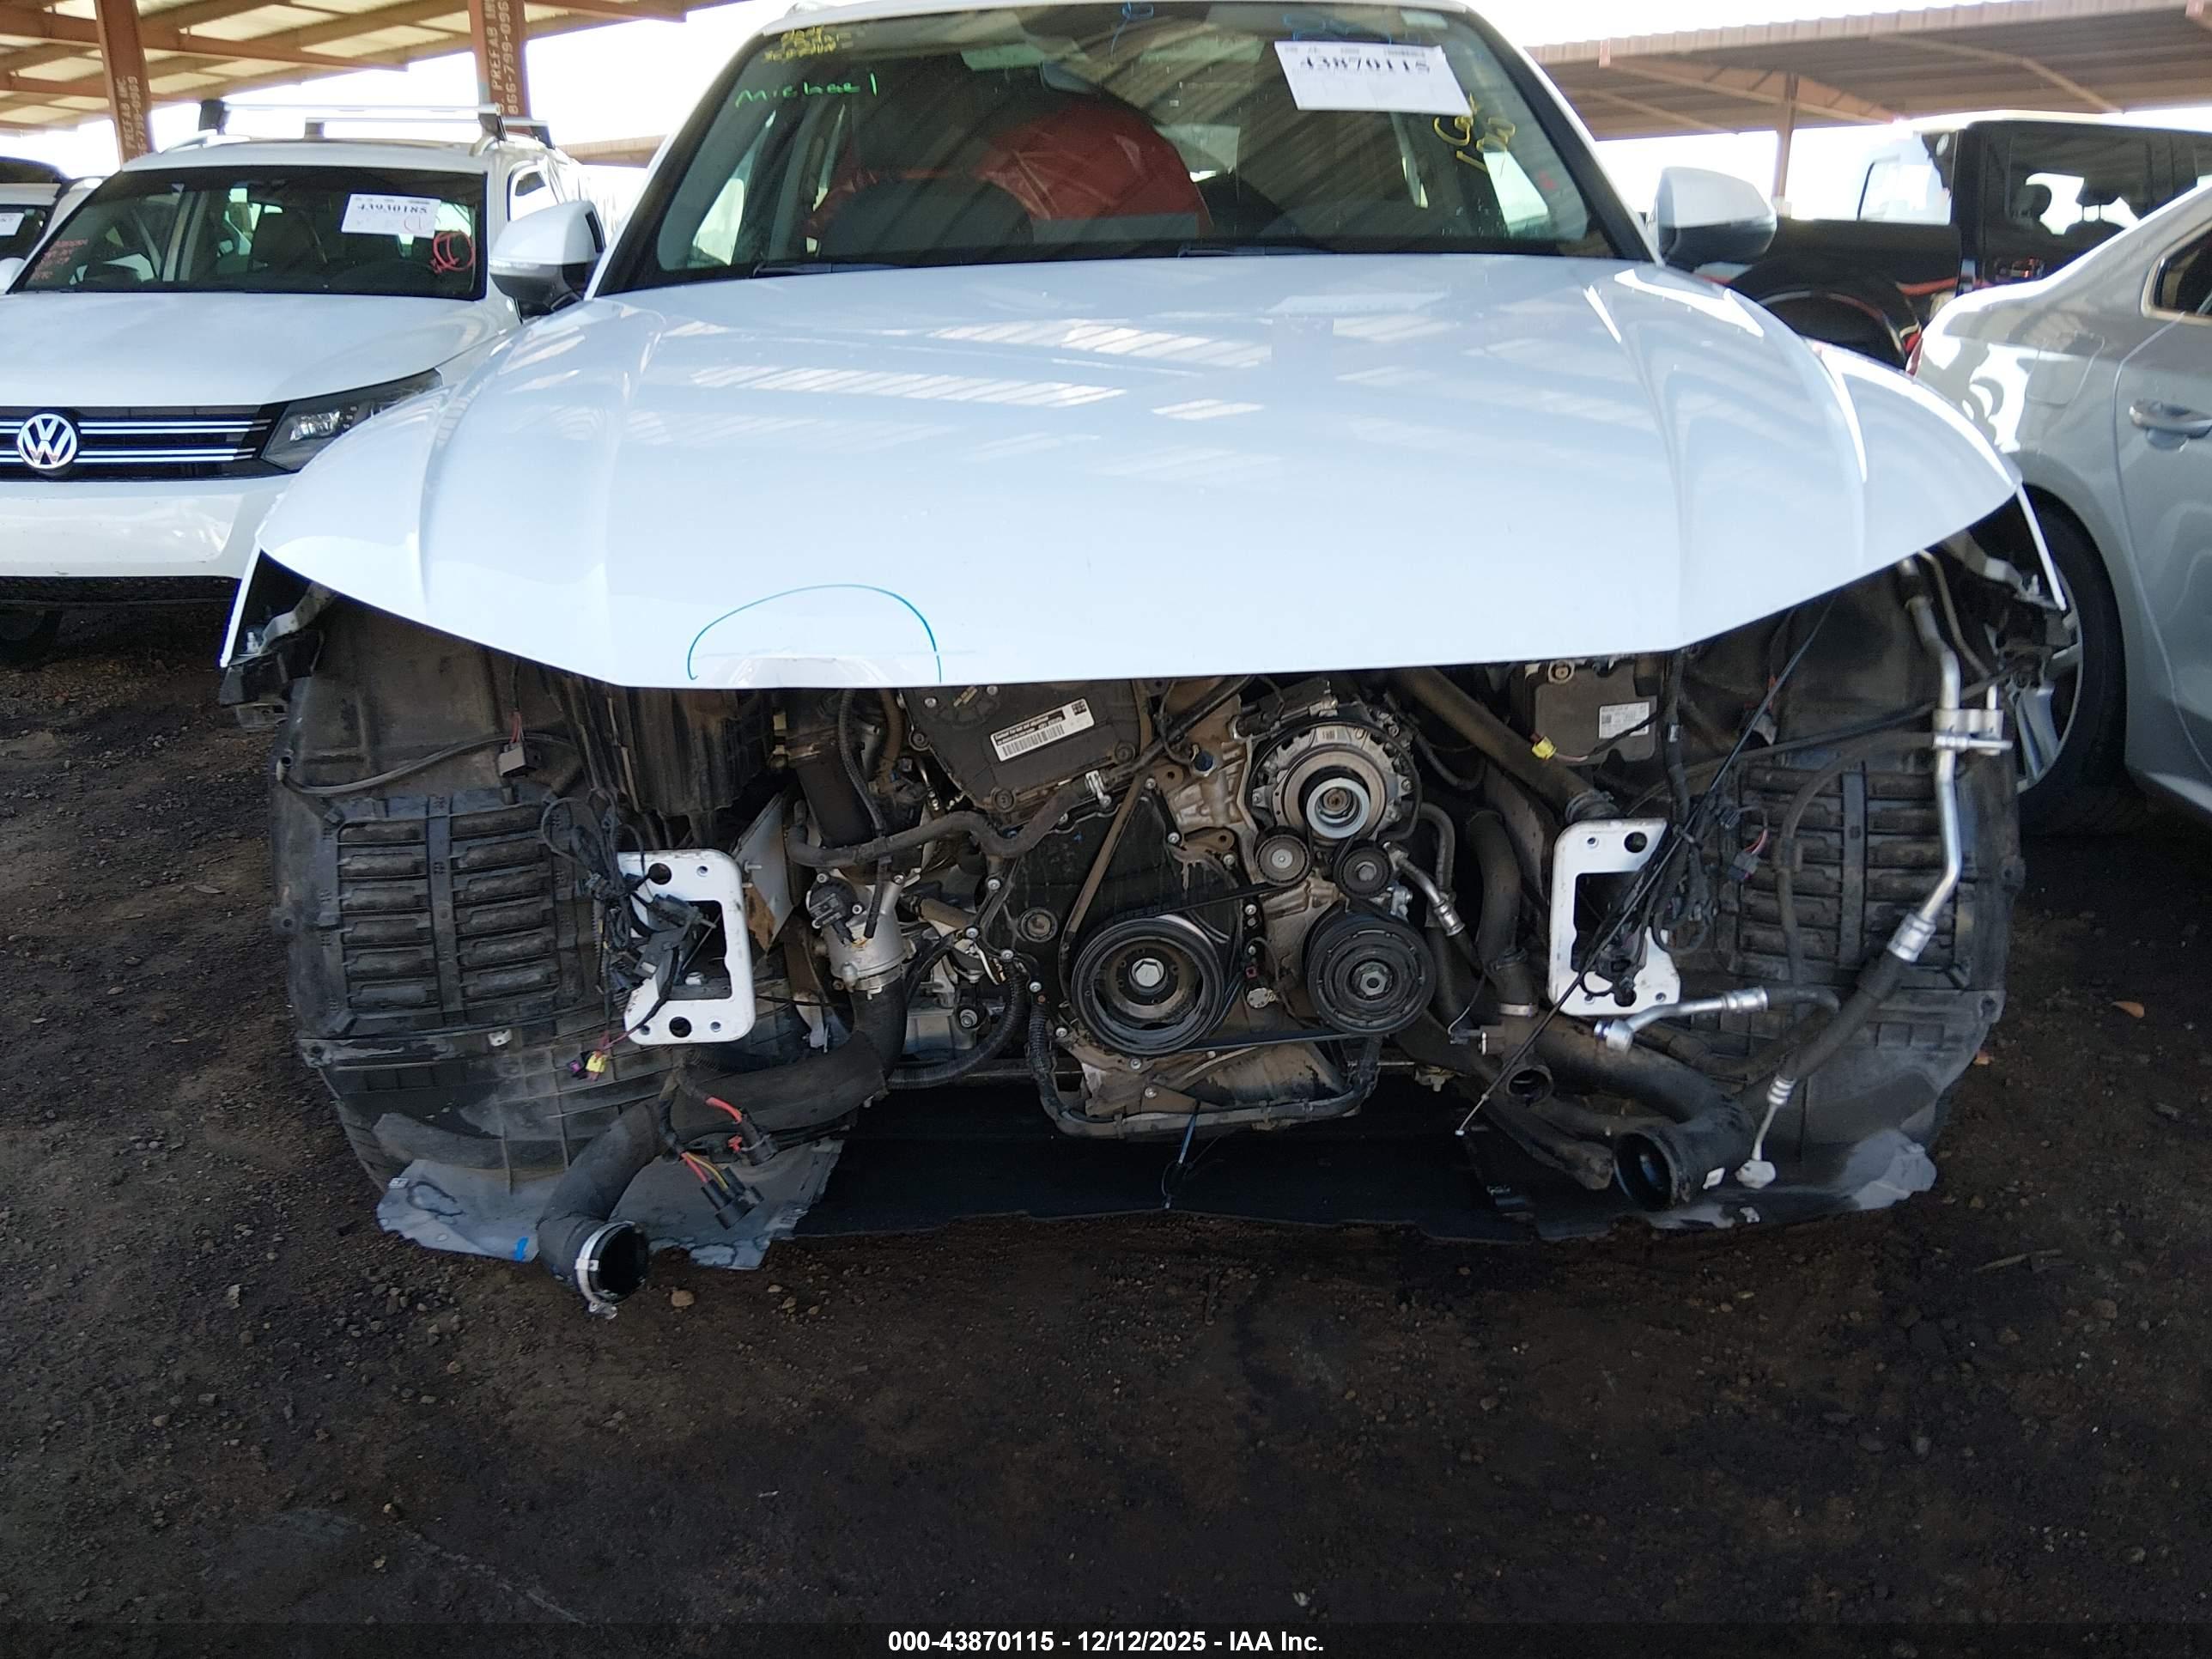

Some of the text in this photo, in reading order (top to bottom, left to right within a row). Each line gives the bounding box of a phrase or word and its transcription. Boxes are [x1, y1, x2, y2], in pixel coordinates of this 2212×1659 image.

[486, 26, 503, 91] PREFAB
[1300, 57, 1431, 74] 43870115
[119, 103, 137, 149] PREFAB
